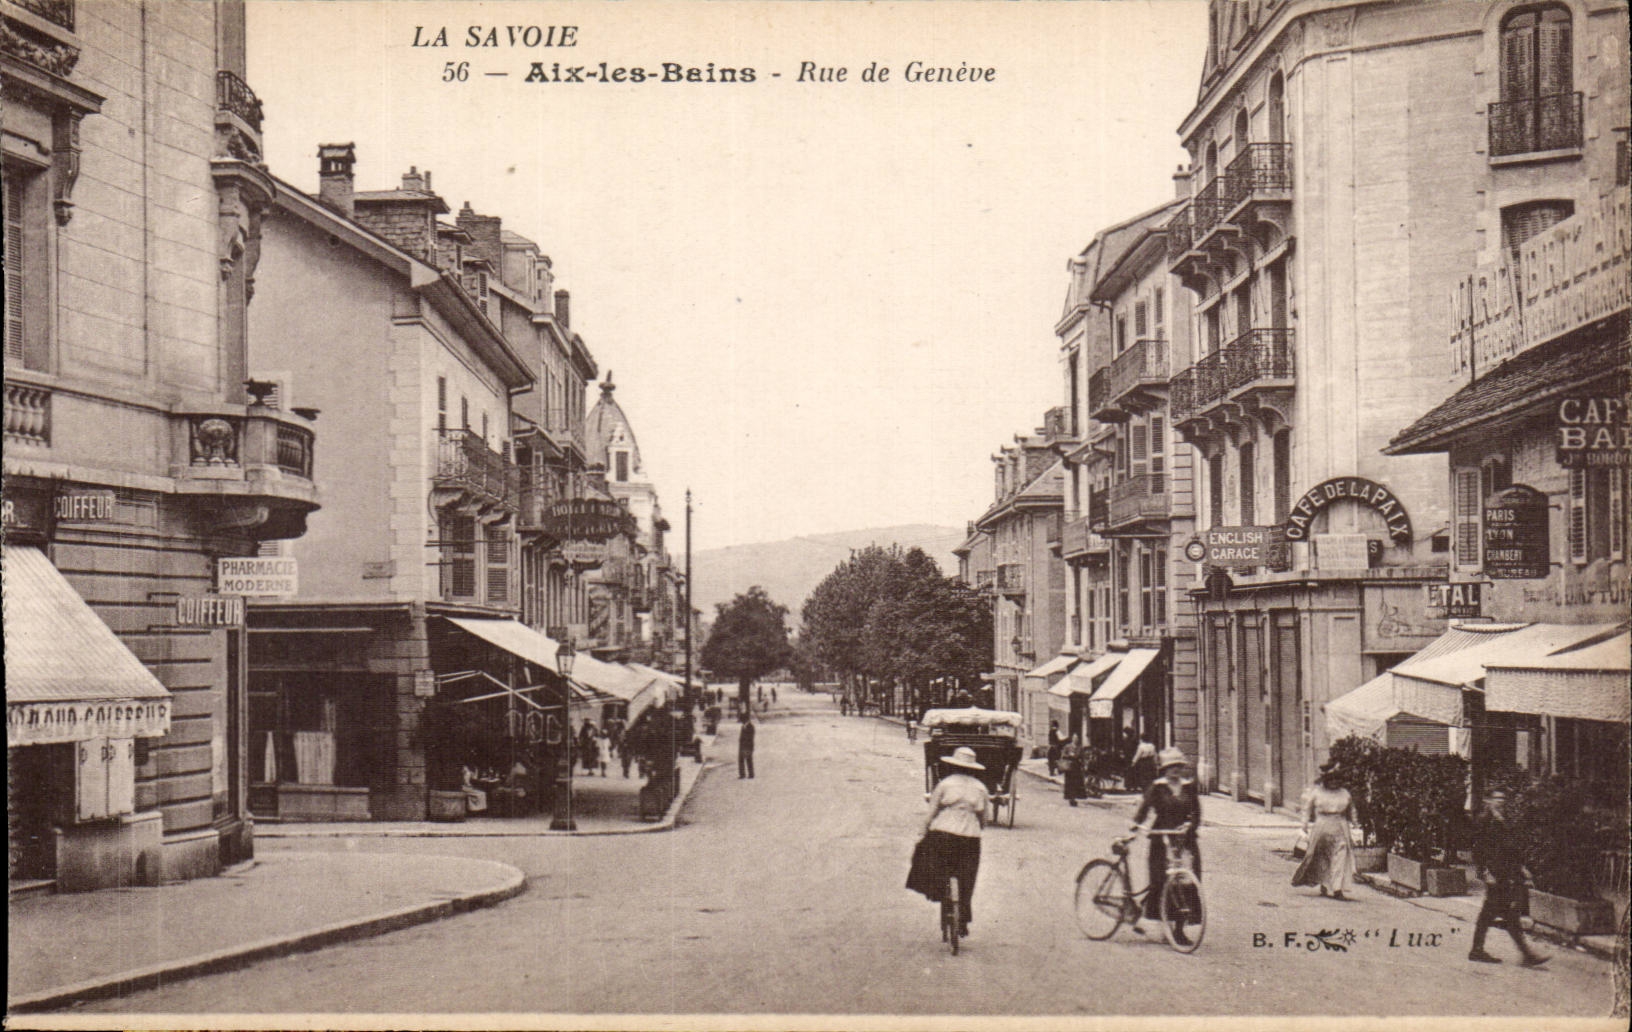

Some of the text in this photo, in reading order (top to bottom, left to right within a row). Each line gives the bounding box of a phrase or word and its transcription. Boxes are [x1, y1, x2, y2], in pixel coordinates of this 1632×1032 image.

[54, 494, 114, 520] COIFFEUR
[1286, 480, 1409, 539] CAFE DE LA PAIX
[1486, 509, 1515, 521] PARIS
[1209, 531, 1264, 545] ENGLISH
[221, 560, 295, 576] PHARMACIE
[223, 579, 293, 592] MODERNE
[178, 598, 243, 625] COIFFEUR
